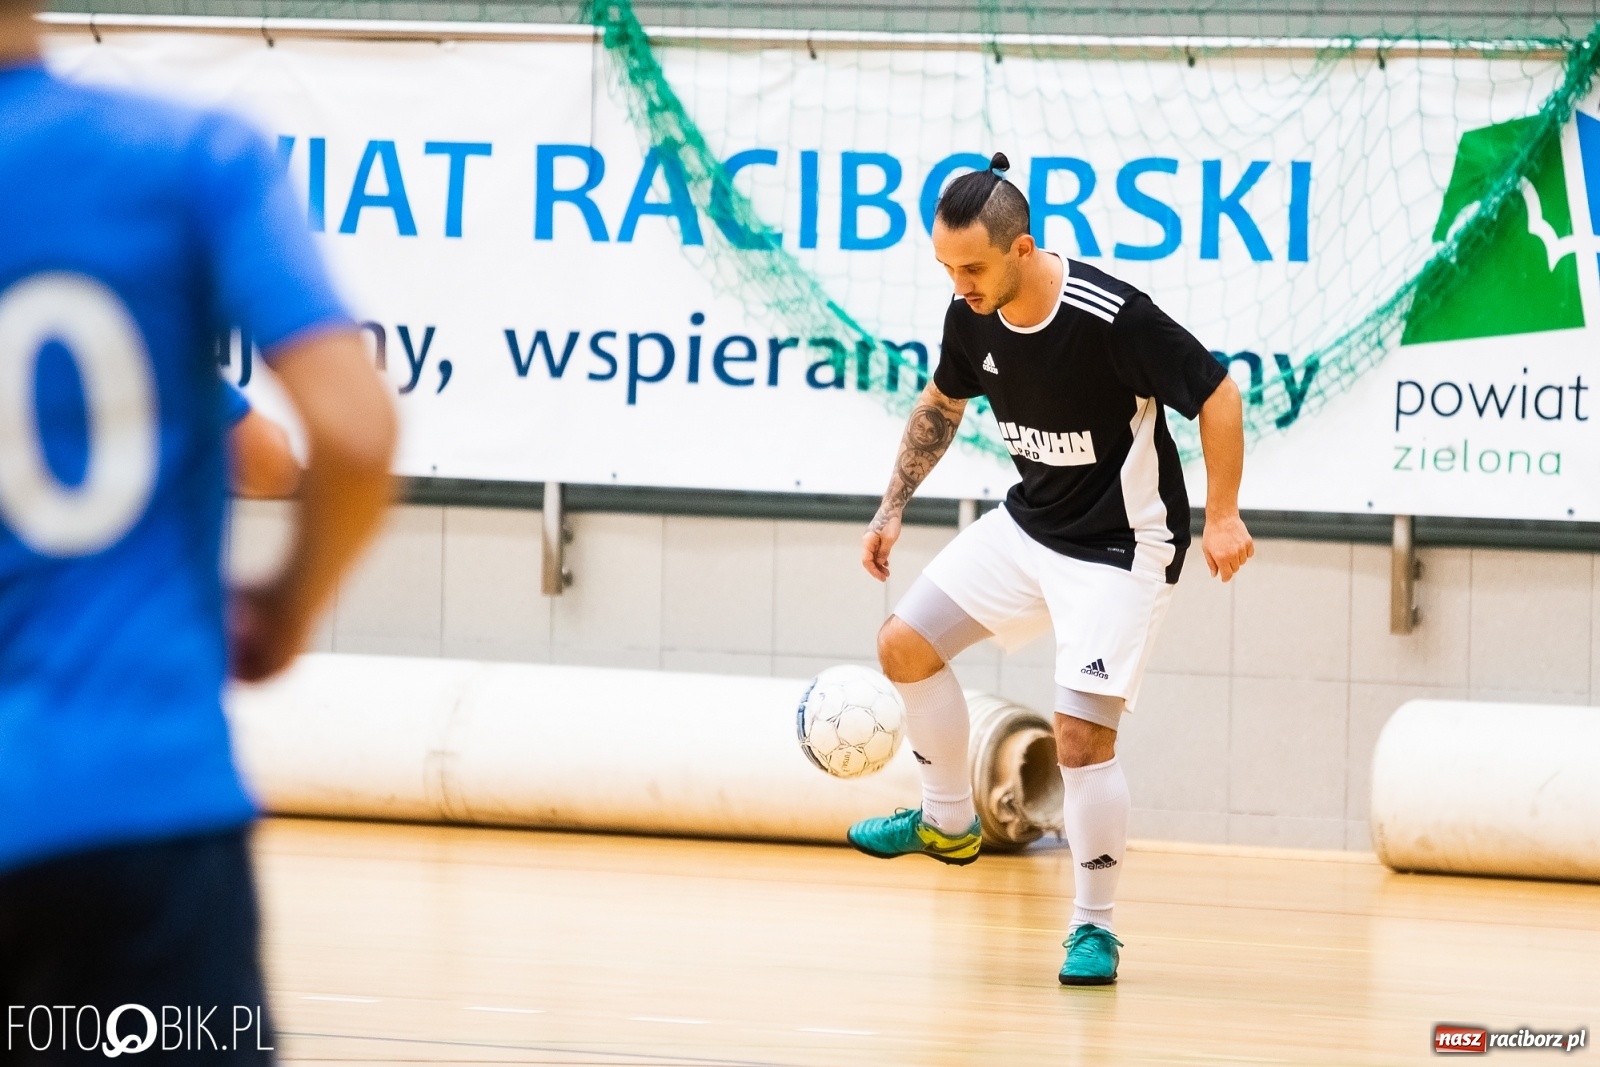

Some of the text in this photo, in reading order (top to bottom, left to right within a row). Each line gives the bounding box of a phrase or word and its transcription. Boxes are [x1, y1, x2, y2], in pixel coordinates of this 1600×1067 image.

[504, 312, 942, 406] wspieram
[1395, 366, 1590, 432] powiat
[1018, 425, 1095, 456] KUHN
[1393, 437, 1562, 476] zielona
[1080, 667, 1109, 680] adidas
[1080, 860, 1118, 871] adidas
